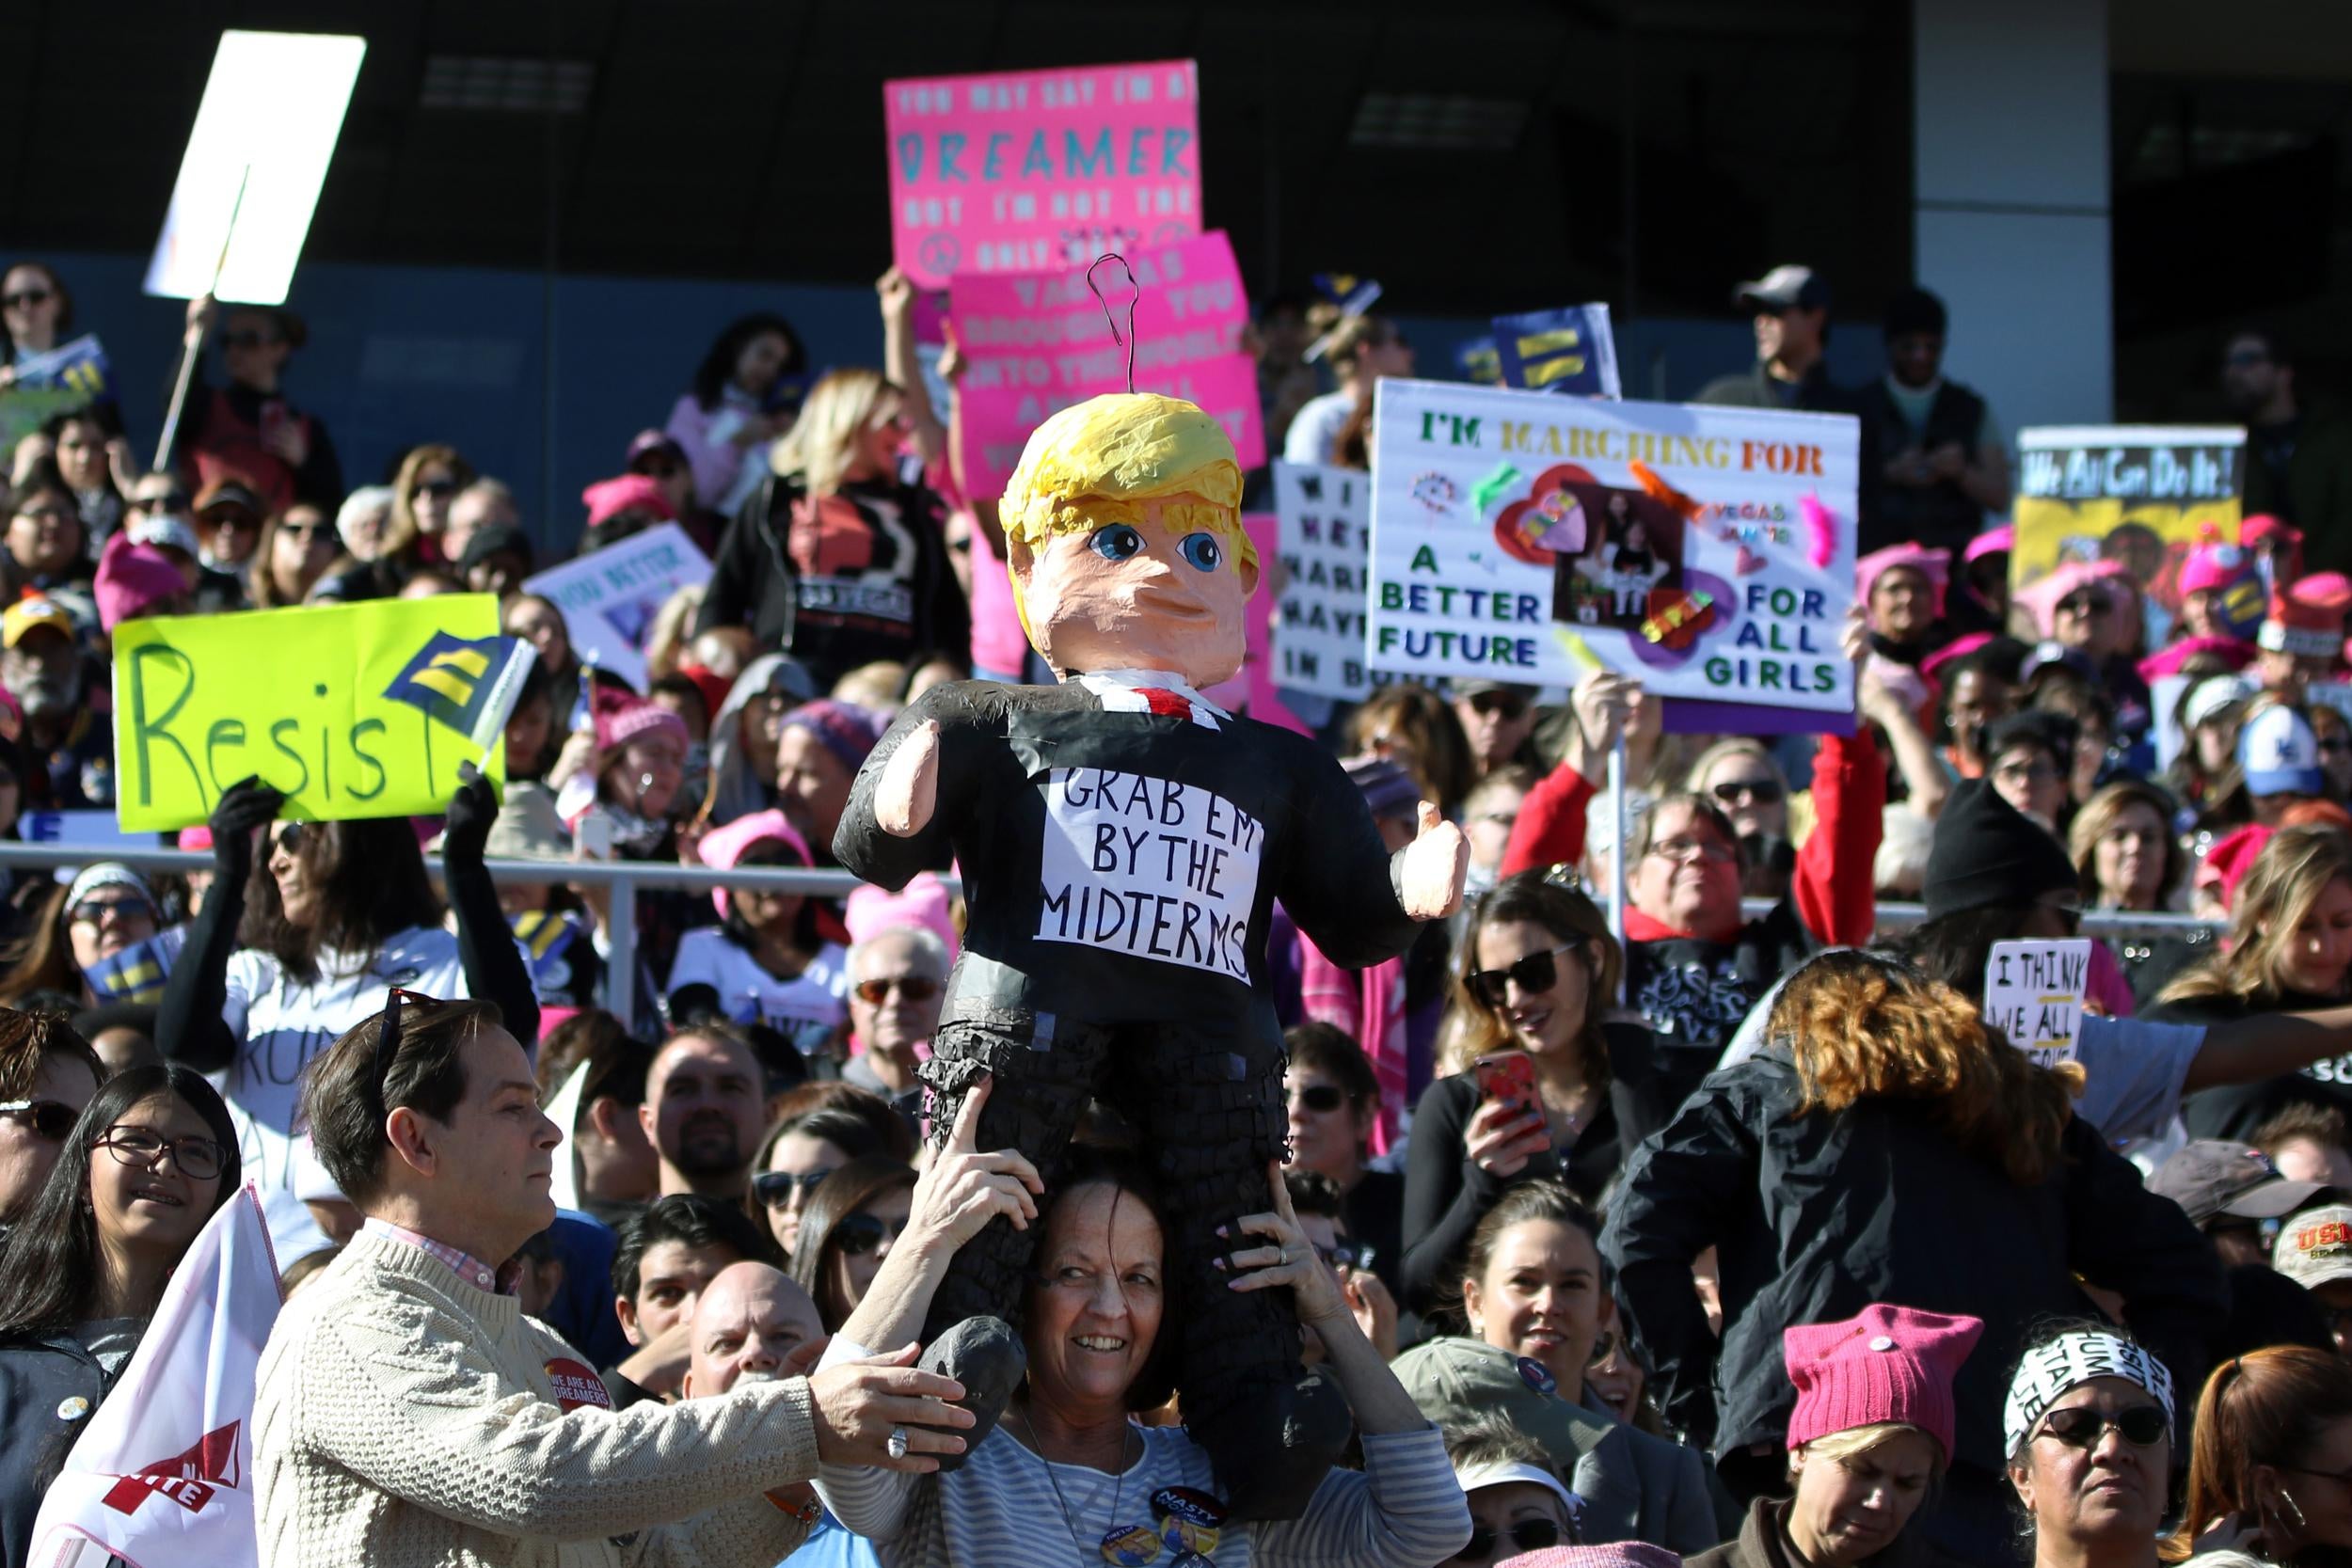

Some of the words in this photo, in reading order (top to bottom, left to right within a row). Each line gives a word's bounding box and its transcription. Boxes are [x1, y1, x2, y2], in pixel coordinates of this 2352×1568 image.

[898, 125, 1193, 185] DREAMER
[1421, 409, 1482, 449] I'M
[1500, 420, 1730, 468] MARCHING
[1741, 440, 1824, 477] FOR
[1410, 544, 1439, 576] A
[1380, 581, 1540, 624] BETTER
[1747, 584, 1825, 619] FOR
[1377, 626, 1538, 667] FUTURE
[1737, 621, 1820, 655] ALL
[1705, 657, 1835, 692] GIRLS
[1063, 768, 1184, 825] GRAB
[1206, 792, 1256, 852] EM
[1092, 823, 1150, 875] BY
[1158, 833, 1229, 899] THE
[1039, 883, 1248, 978] MIDTERMS
[1997, 954, 2011, 986] I
[2020, 950, 2087, 990] THINK
[1990, 1006, 2026, 1038] WE
[2036, 1004, 2072, 1039] ALL
[549, 1373, 566, 1386] WE
[566, 1375, 586, 1389] ARE
[587, 1379, 605, 1393] ALL
[553, 1386, 609, 1406] DREAMERS
[1159, 1490, 1218, 1521] NASTY
